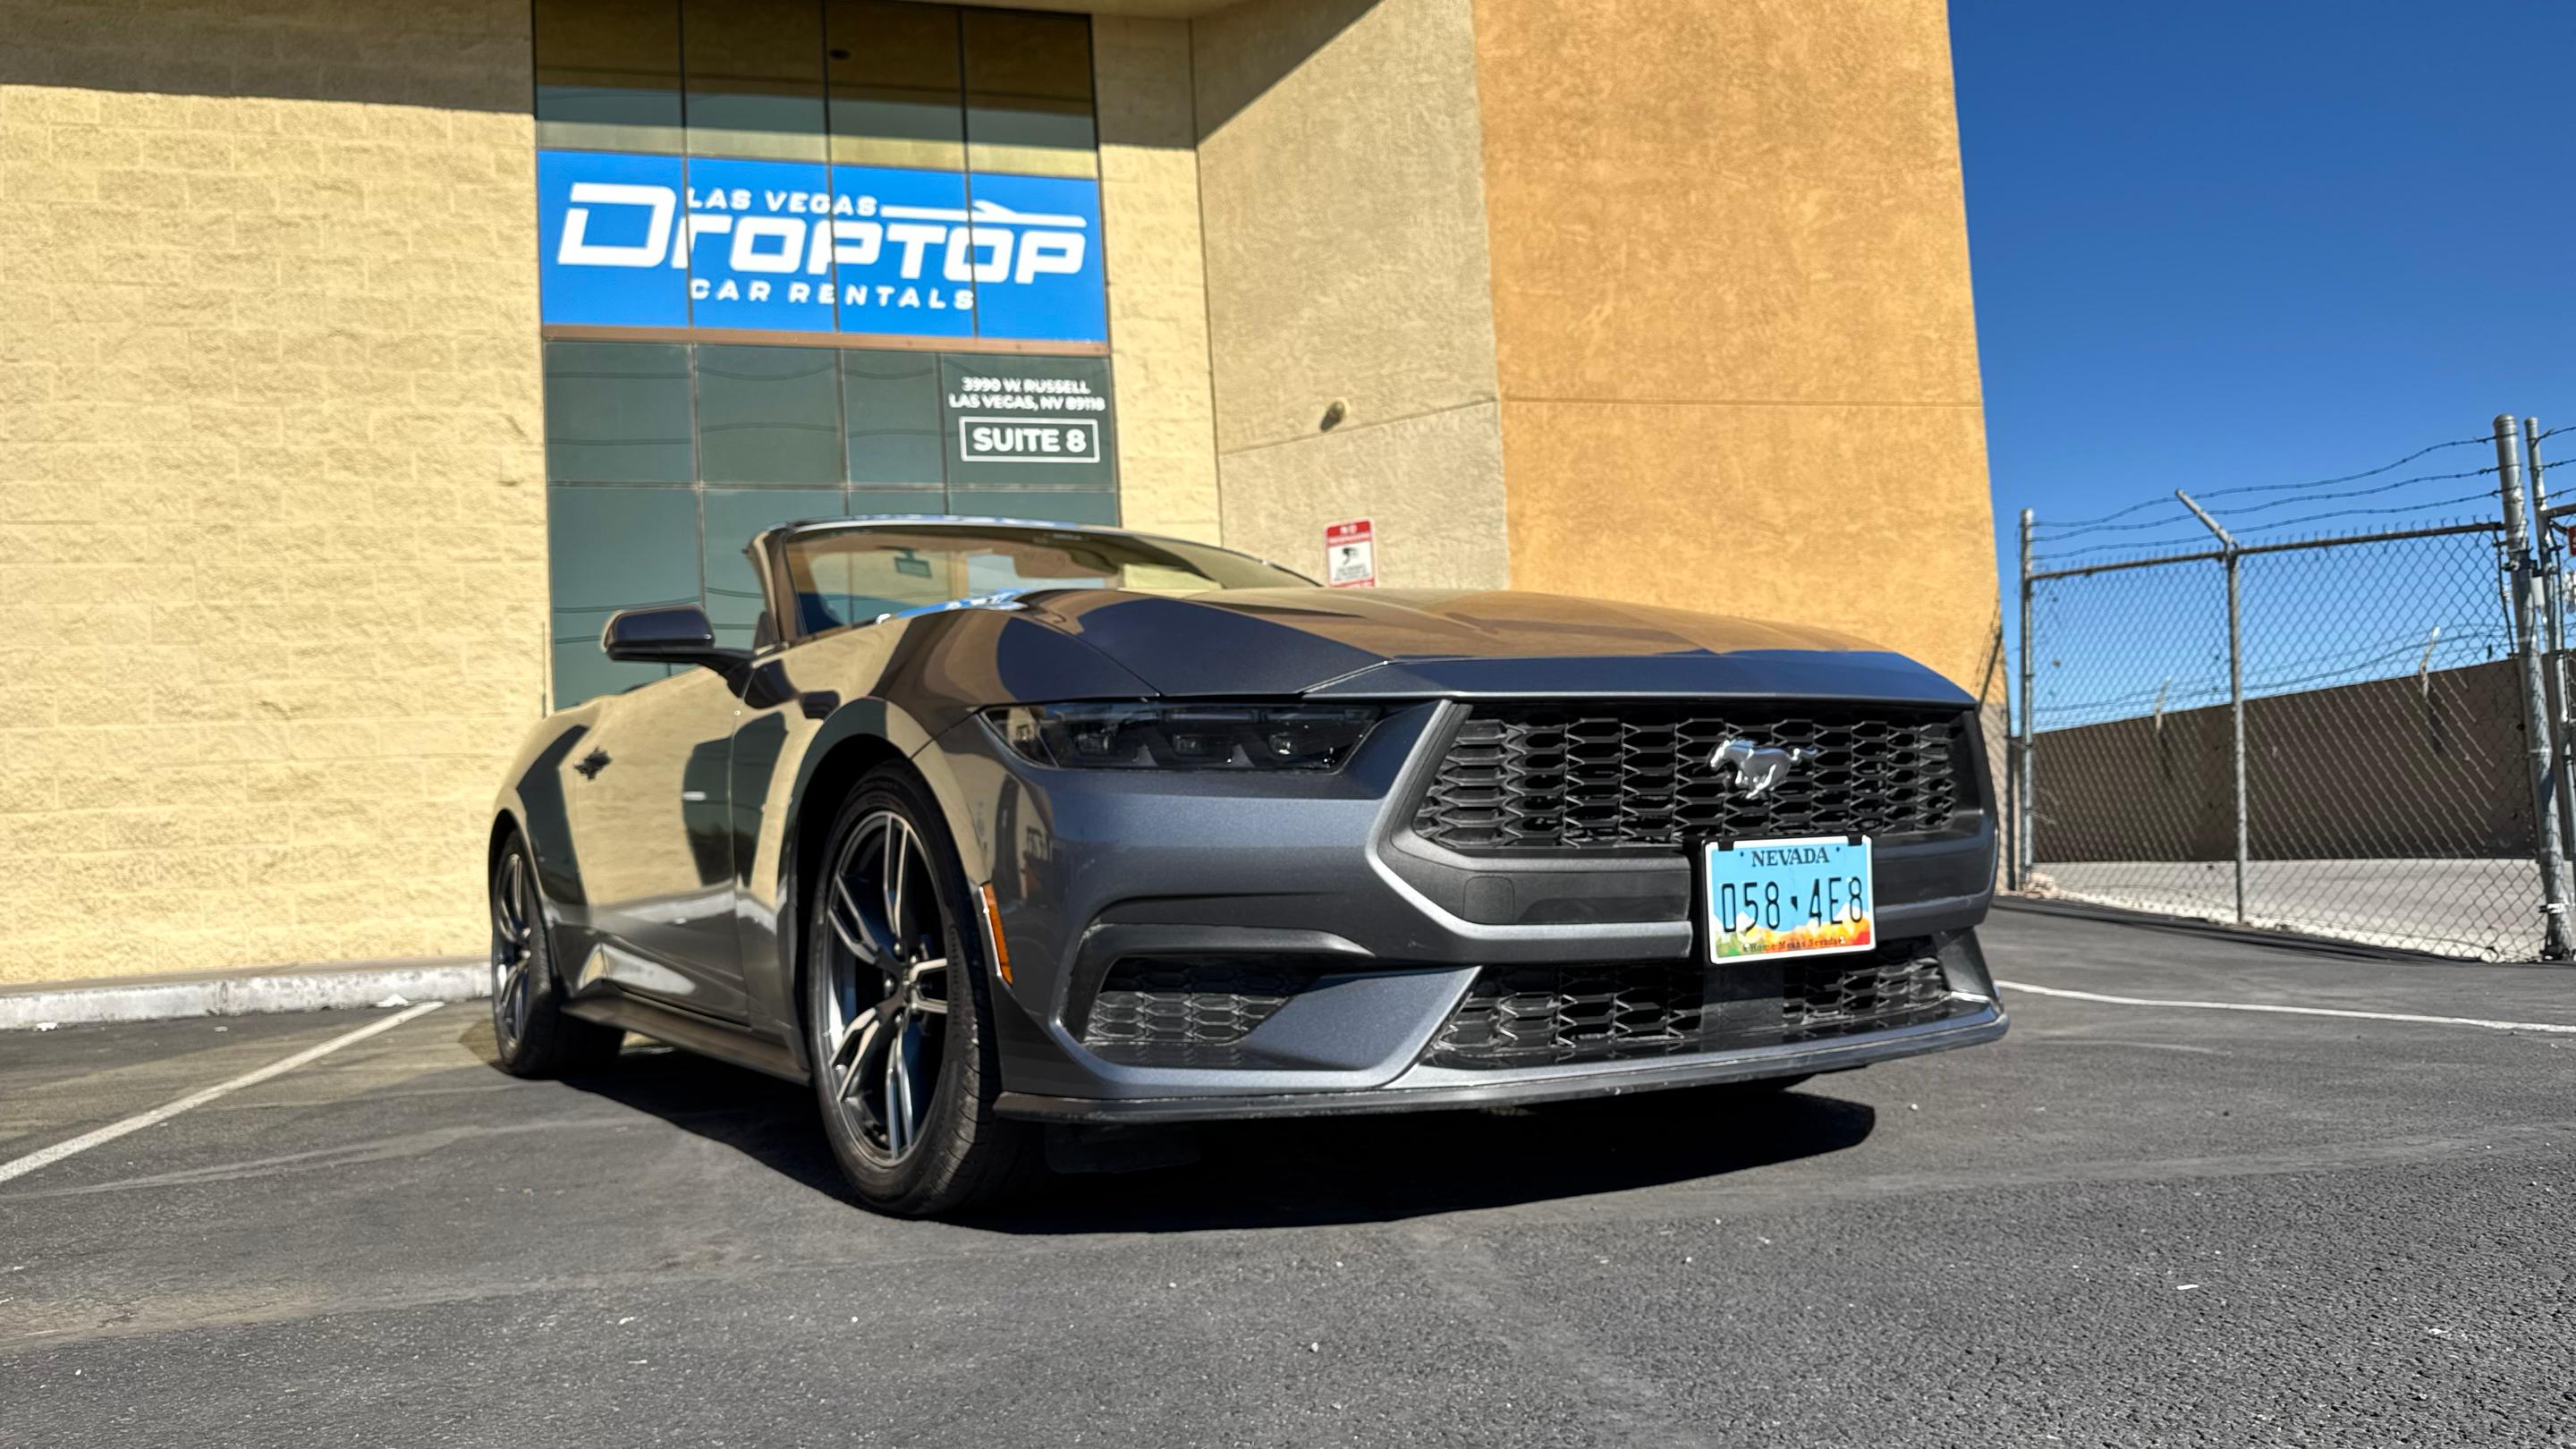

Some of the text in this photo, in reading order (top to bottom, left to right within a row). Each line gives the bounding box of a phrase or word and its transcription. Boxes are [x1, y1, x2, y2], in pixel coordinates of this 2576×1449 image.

[687, 187, 877, 216] LAS VEGAS
[690, 279, 975, 310] CAR RENTALS
[962, 377, 1002, 392] 3990
[1023, 378, 1091, 394] RUSSELL
[948, 394, 981, 408] LAS
[981, 395, 1039, 411] VEGAS,
[1040, 397, 1064, 410] NV
[972, 427, 1088, 453] SUITE 8
[1751, 847, 1830, 867] NEVADA
